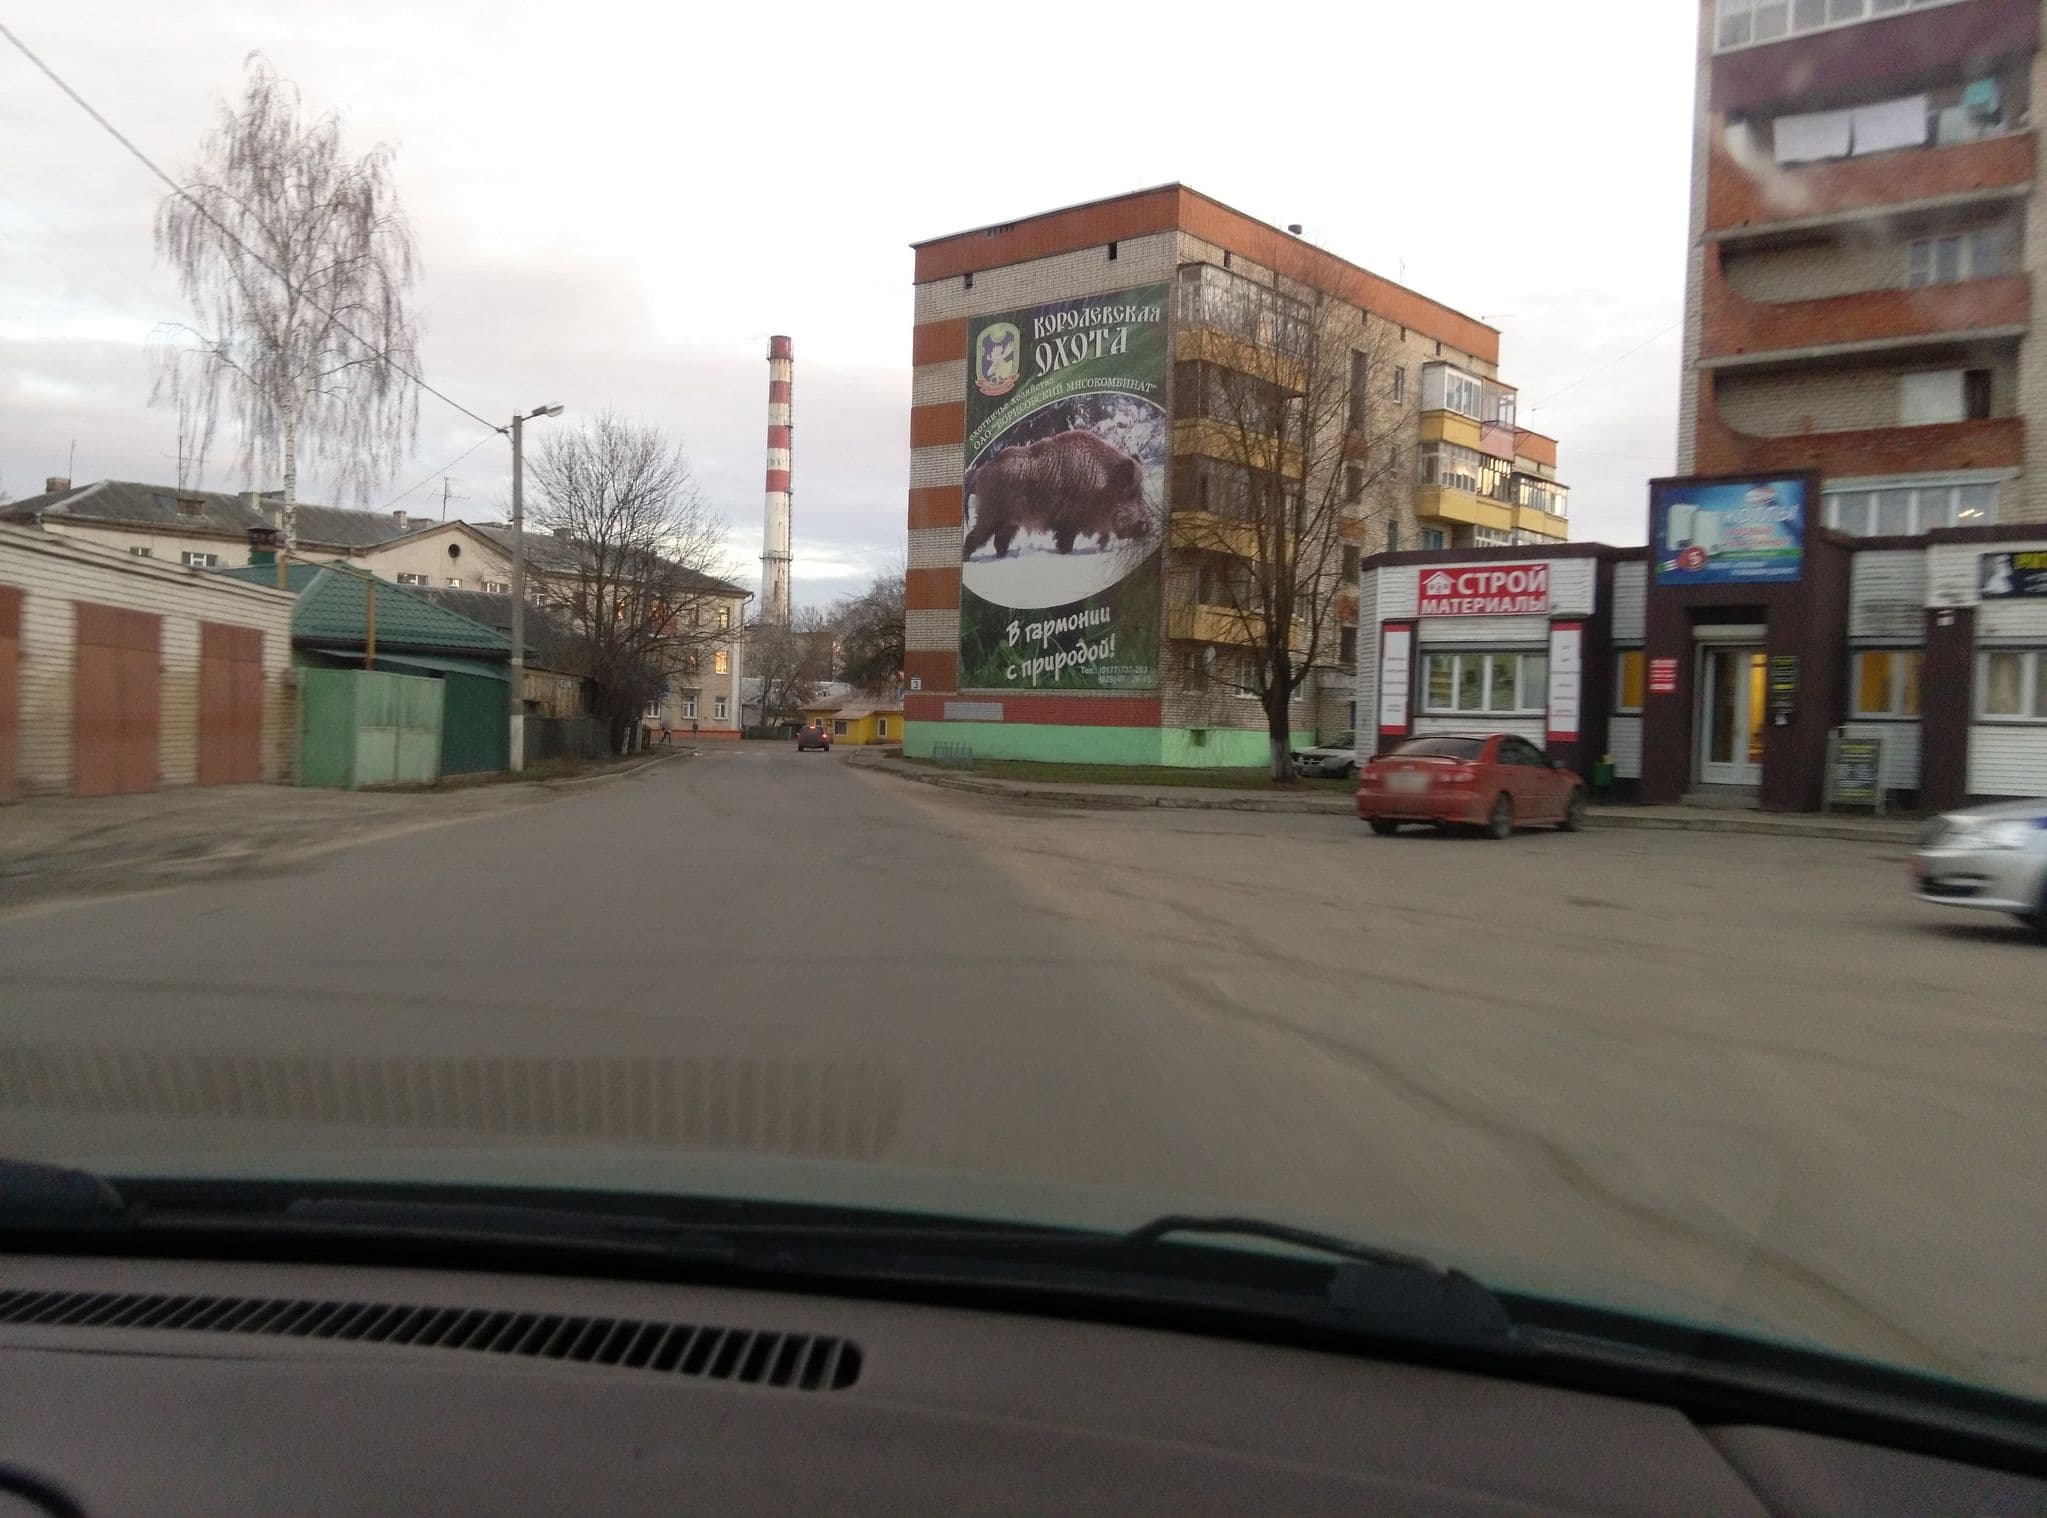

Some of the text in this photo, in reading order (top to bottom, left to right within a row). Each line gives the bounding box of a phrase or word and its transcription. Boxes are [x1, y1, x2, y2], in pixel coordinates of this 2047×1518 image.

[1033, 305, 1160, 339] КОРОЛЕВСКАЯ
[1035, 326, 1128, 377] ОХОТА
[973, 429, 992, 450] ОАО
[1457, 565, 1547, 595] СТРОЙ
[1421, 595, 1546, 615] МАТЕРИАЛЫ
[1006, 606, 1111, 649] В гармонии
[1006, 632, 1116, 687] с природой!
[913, 680, 919, 689] 3
